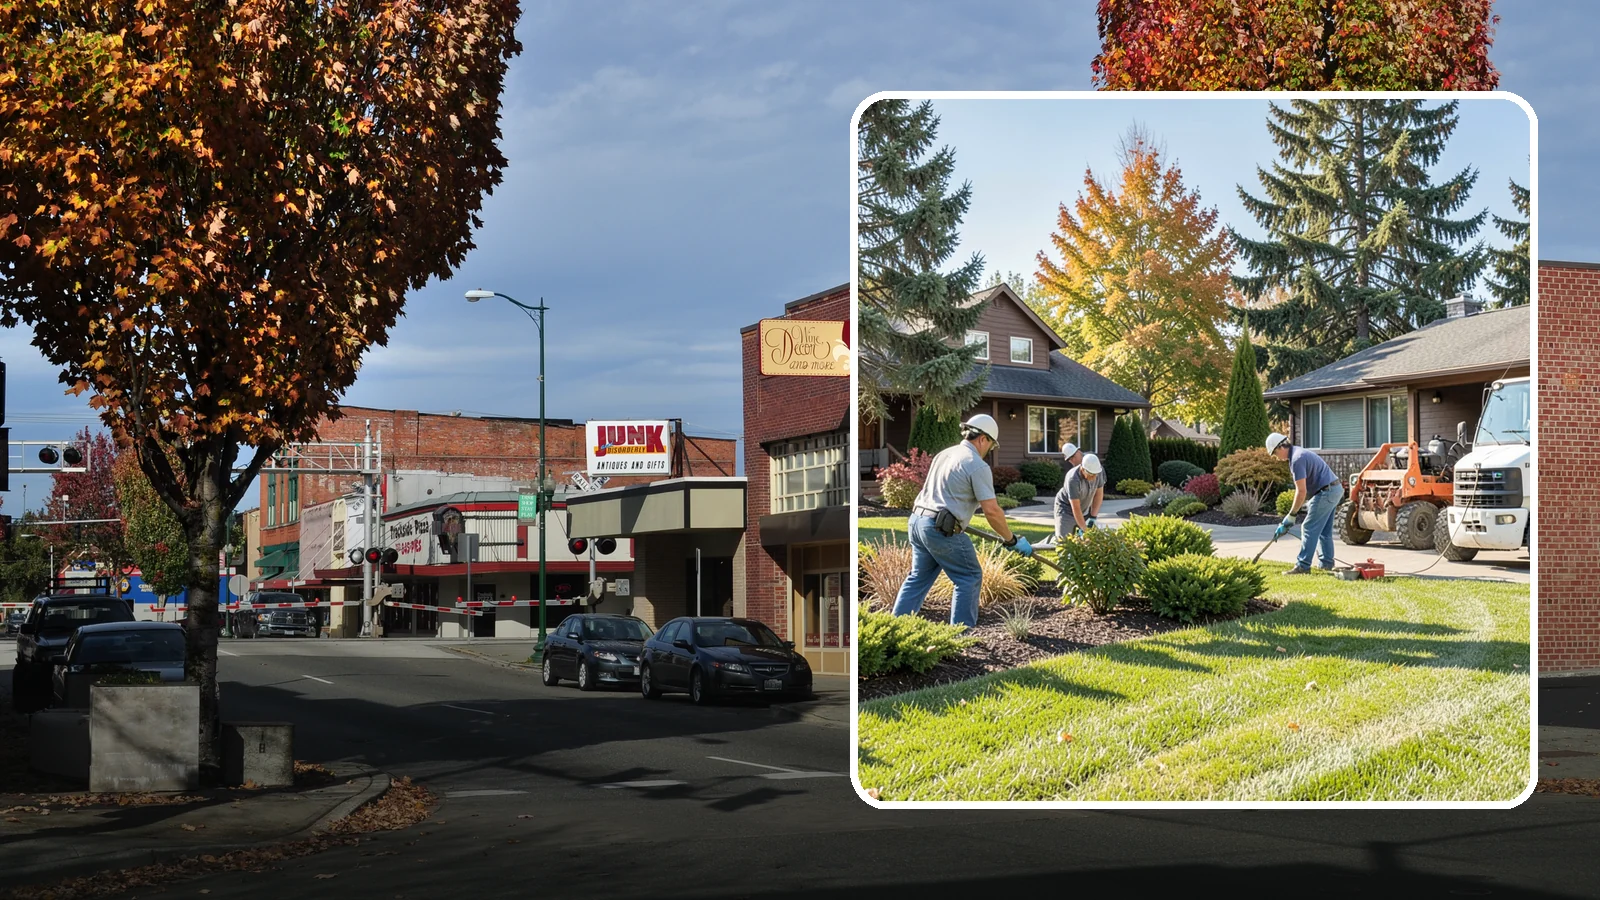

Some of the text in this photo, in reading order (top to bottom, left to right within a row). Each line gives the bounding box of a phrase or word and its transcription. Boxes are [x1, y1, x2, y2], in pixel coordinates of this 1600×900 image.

[765, 327, 831, 365] Decor
[595, 425, 667, 457] JUNK
[607, 446, 645, 454] DISORDERLY
[597, 460, 665, 470] ANTIQUES AND GIFTS
[590, 477, 608, 491] SING
[352, 499, 364, 511] CRO
[414, 519, 429, 535] Pizza
